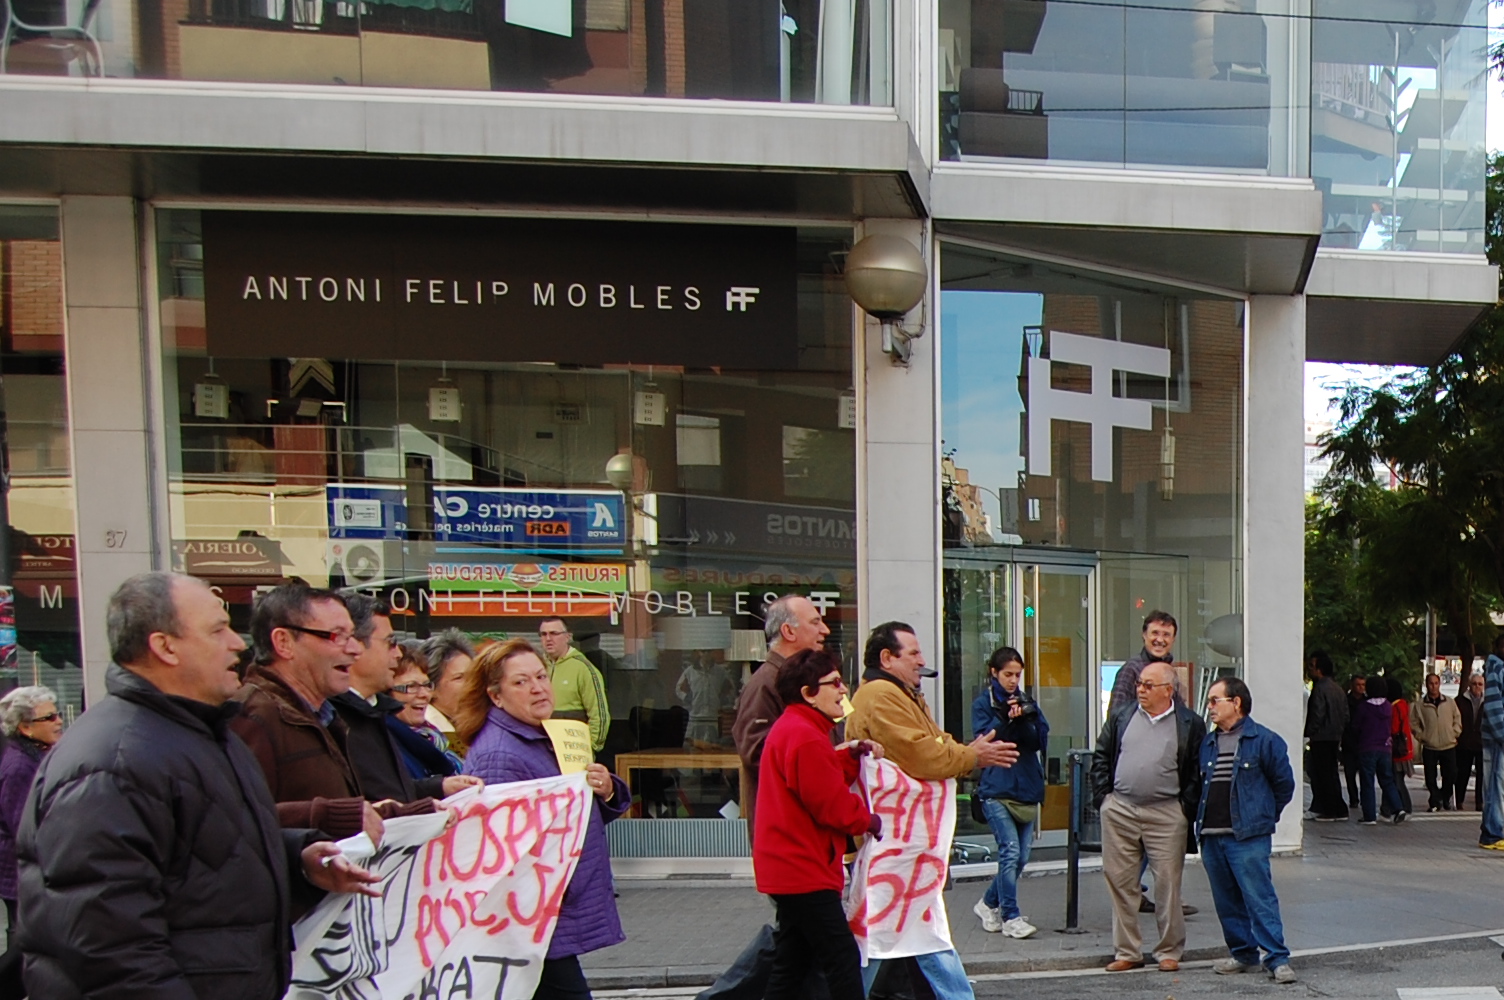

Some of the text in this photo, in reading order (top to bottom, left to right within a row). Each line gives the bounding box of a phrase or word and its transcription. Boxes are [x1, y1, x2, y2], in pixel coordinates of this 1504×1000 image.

[243, 275, 701, 311] ANTONI FELIP MOBLES
